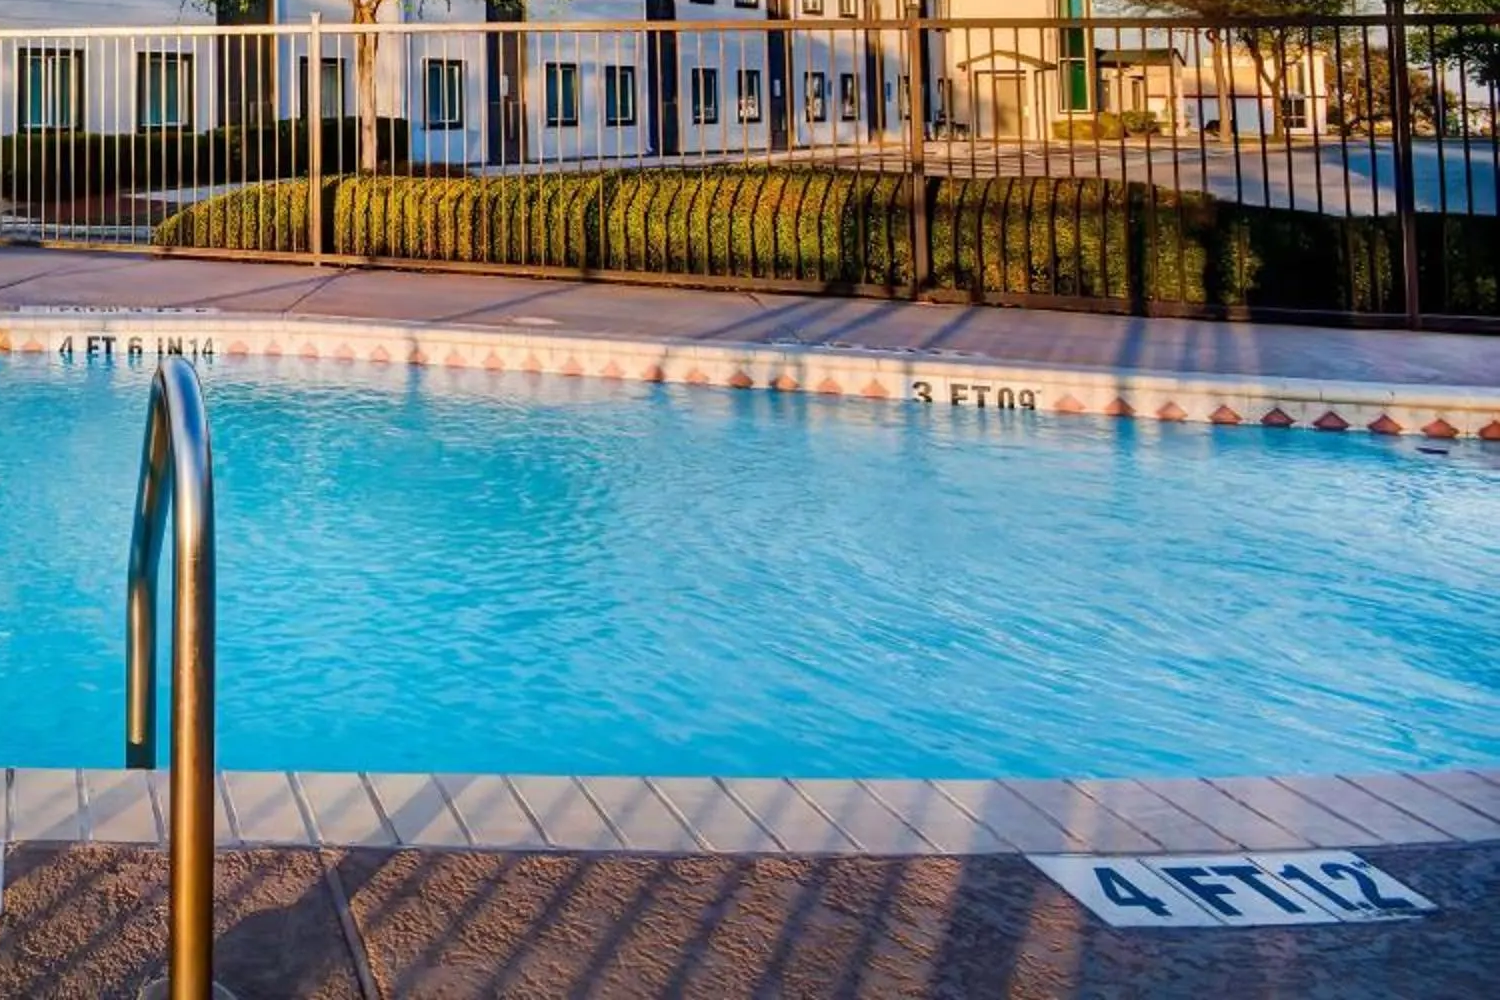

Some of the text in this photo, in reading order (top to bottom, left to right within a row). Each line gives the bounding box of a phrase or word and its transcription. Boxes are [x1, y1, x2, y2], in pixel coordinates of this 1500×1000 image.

[59, 336, 74, 355] 4
[87, 336, 117, 355] FT
[157, 337, 183, 355] IN
[912, 381, 933, 403] 3
[950, 383, 991, 408] FT
[1093, 866, 1173, 917] 4
[1161, 865, 1307, 917] FT
